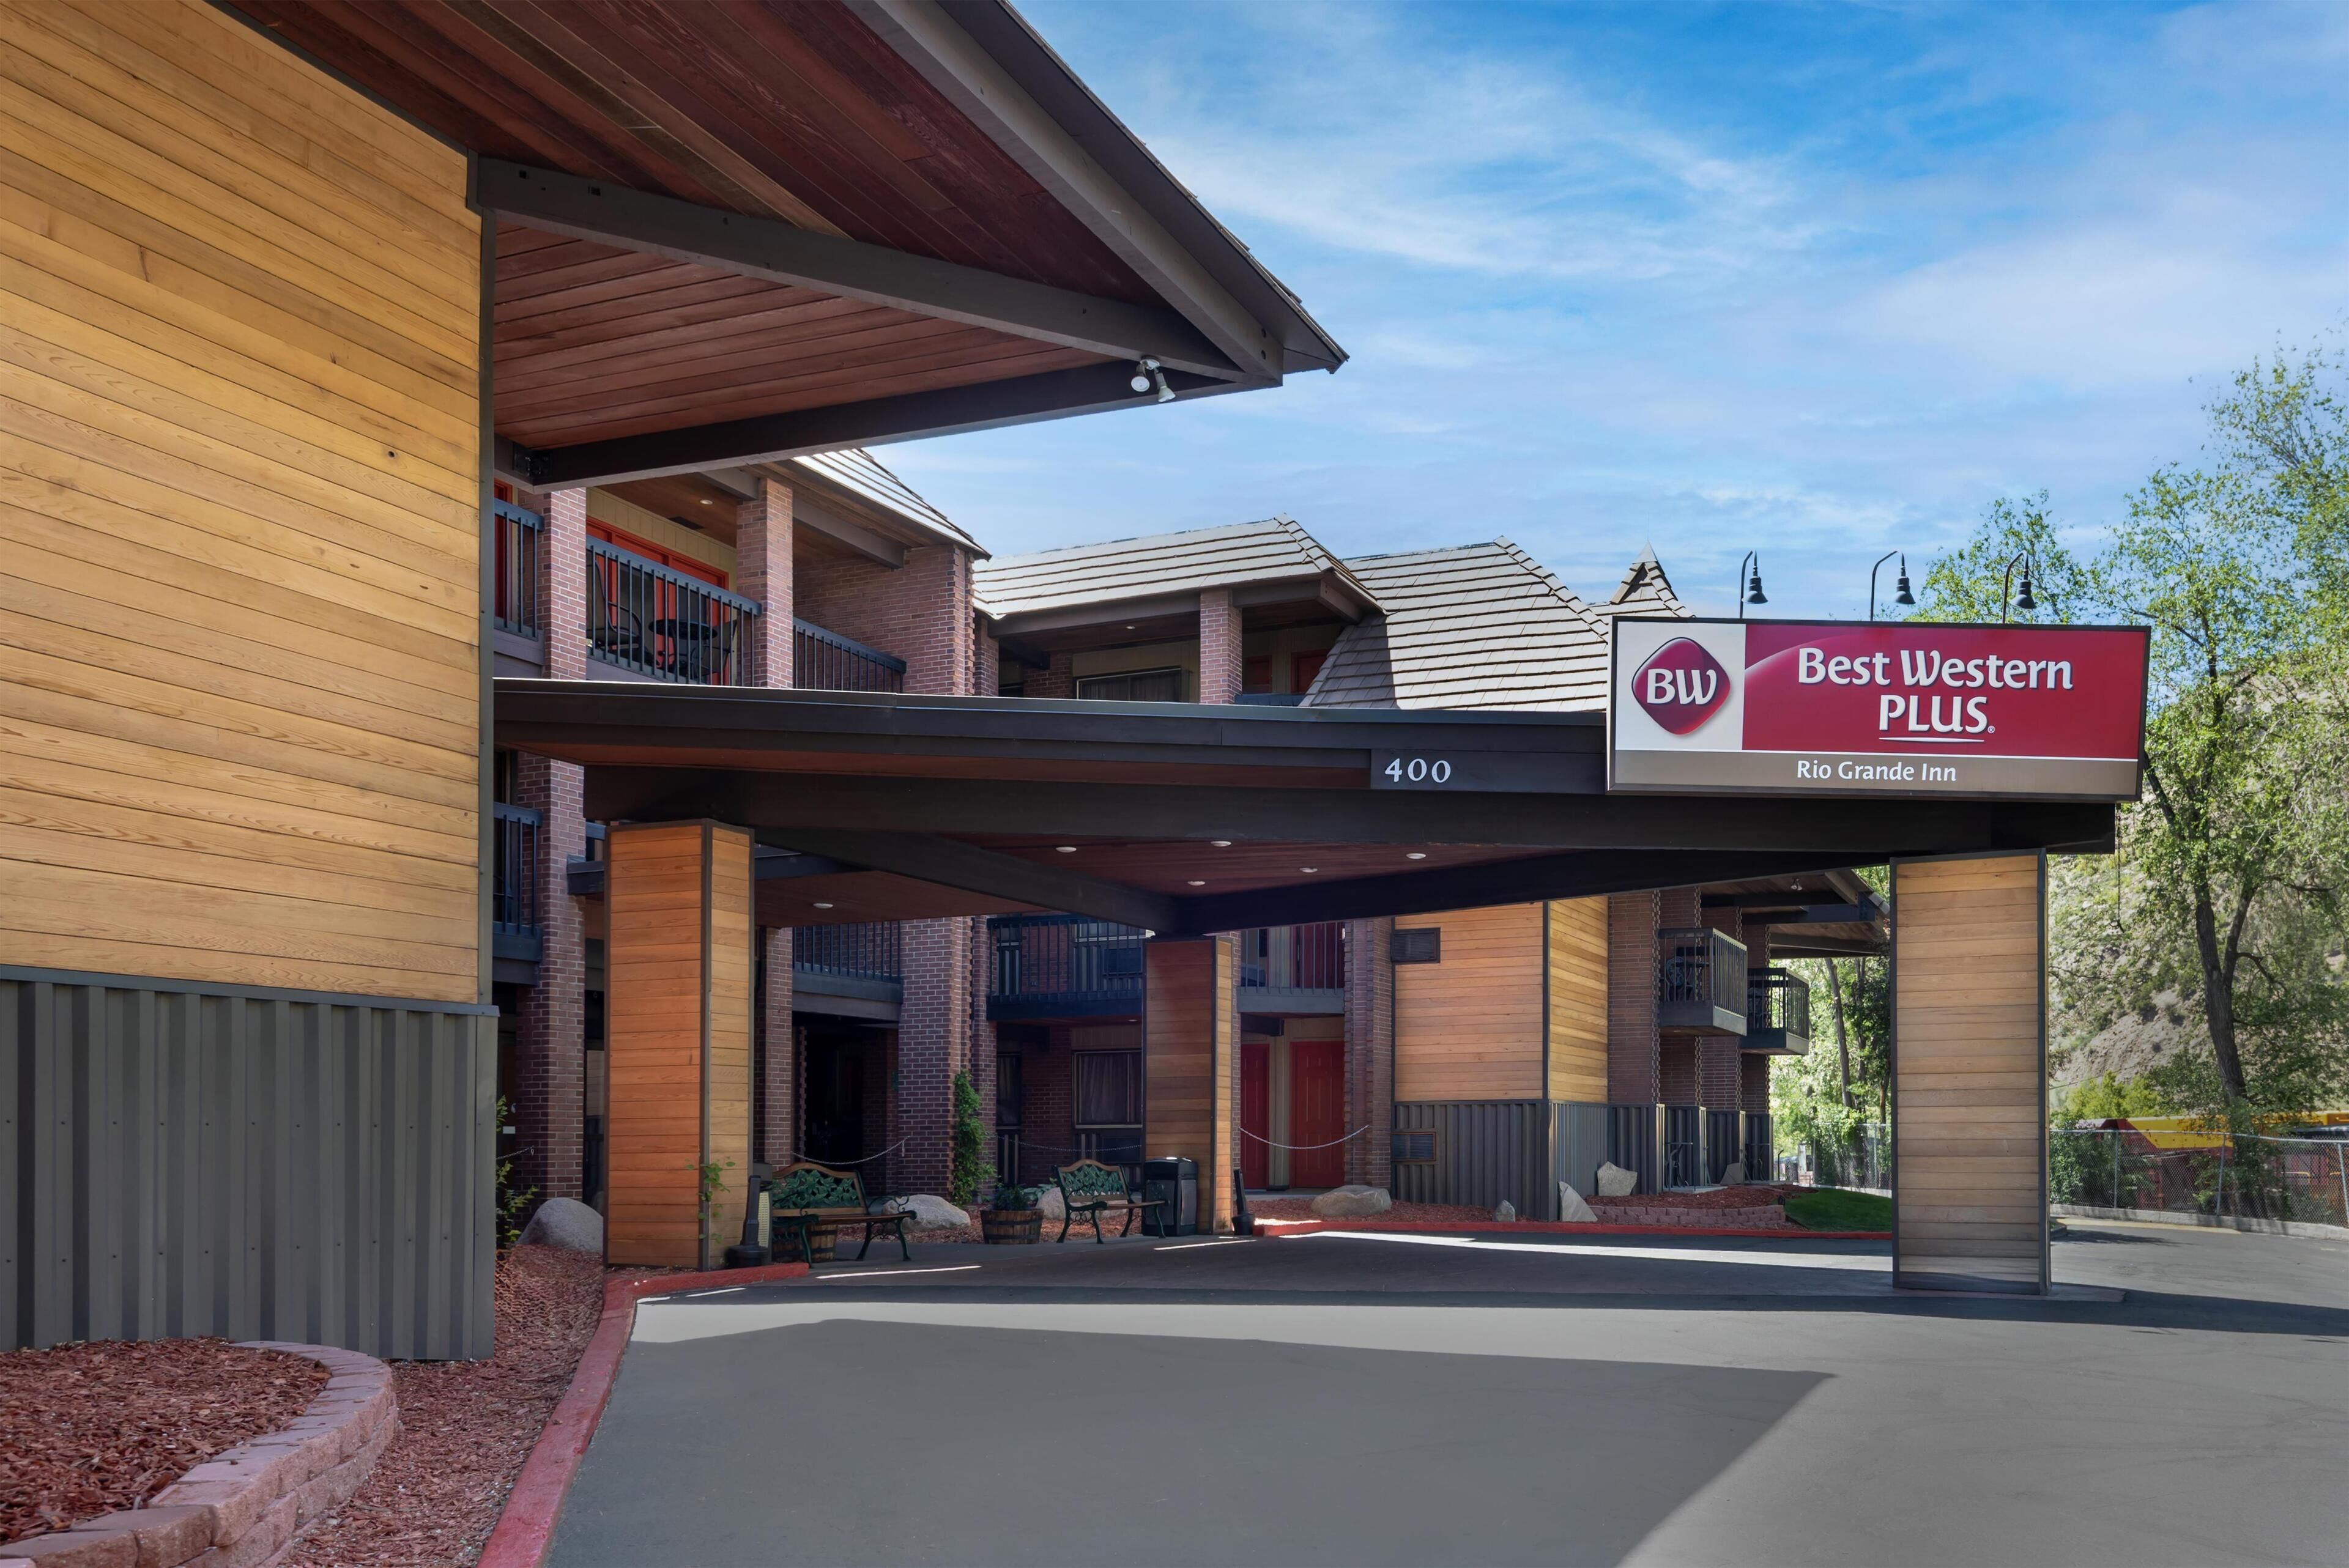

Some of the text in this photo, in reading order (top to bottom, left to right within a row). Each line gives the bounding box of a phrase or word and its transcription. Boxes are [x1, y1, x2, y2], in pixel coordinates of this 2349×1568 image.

[1798, 647, 2073, 690] Best Western
[1647, 668, 1717, 705] BW
[1384, 758, 1451, 783] 400
[1797, 760, 1957, 782] Rio Grande Inn
